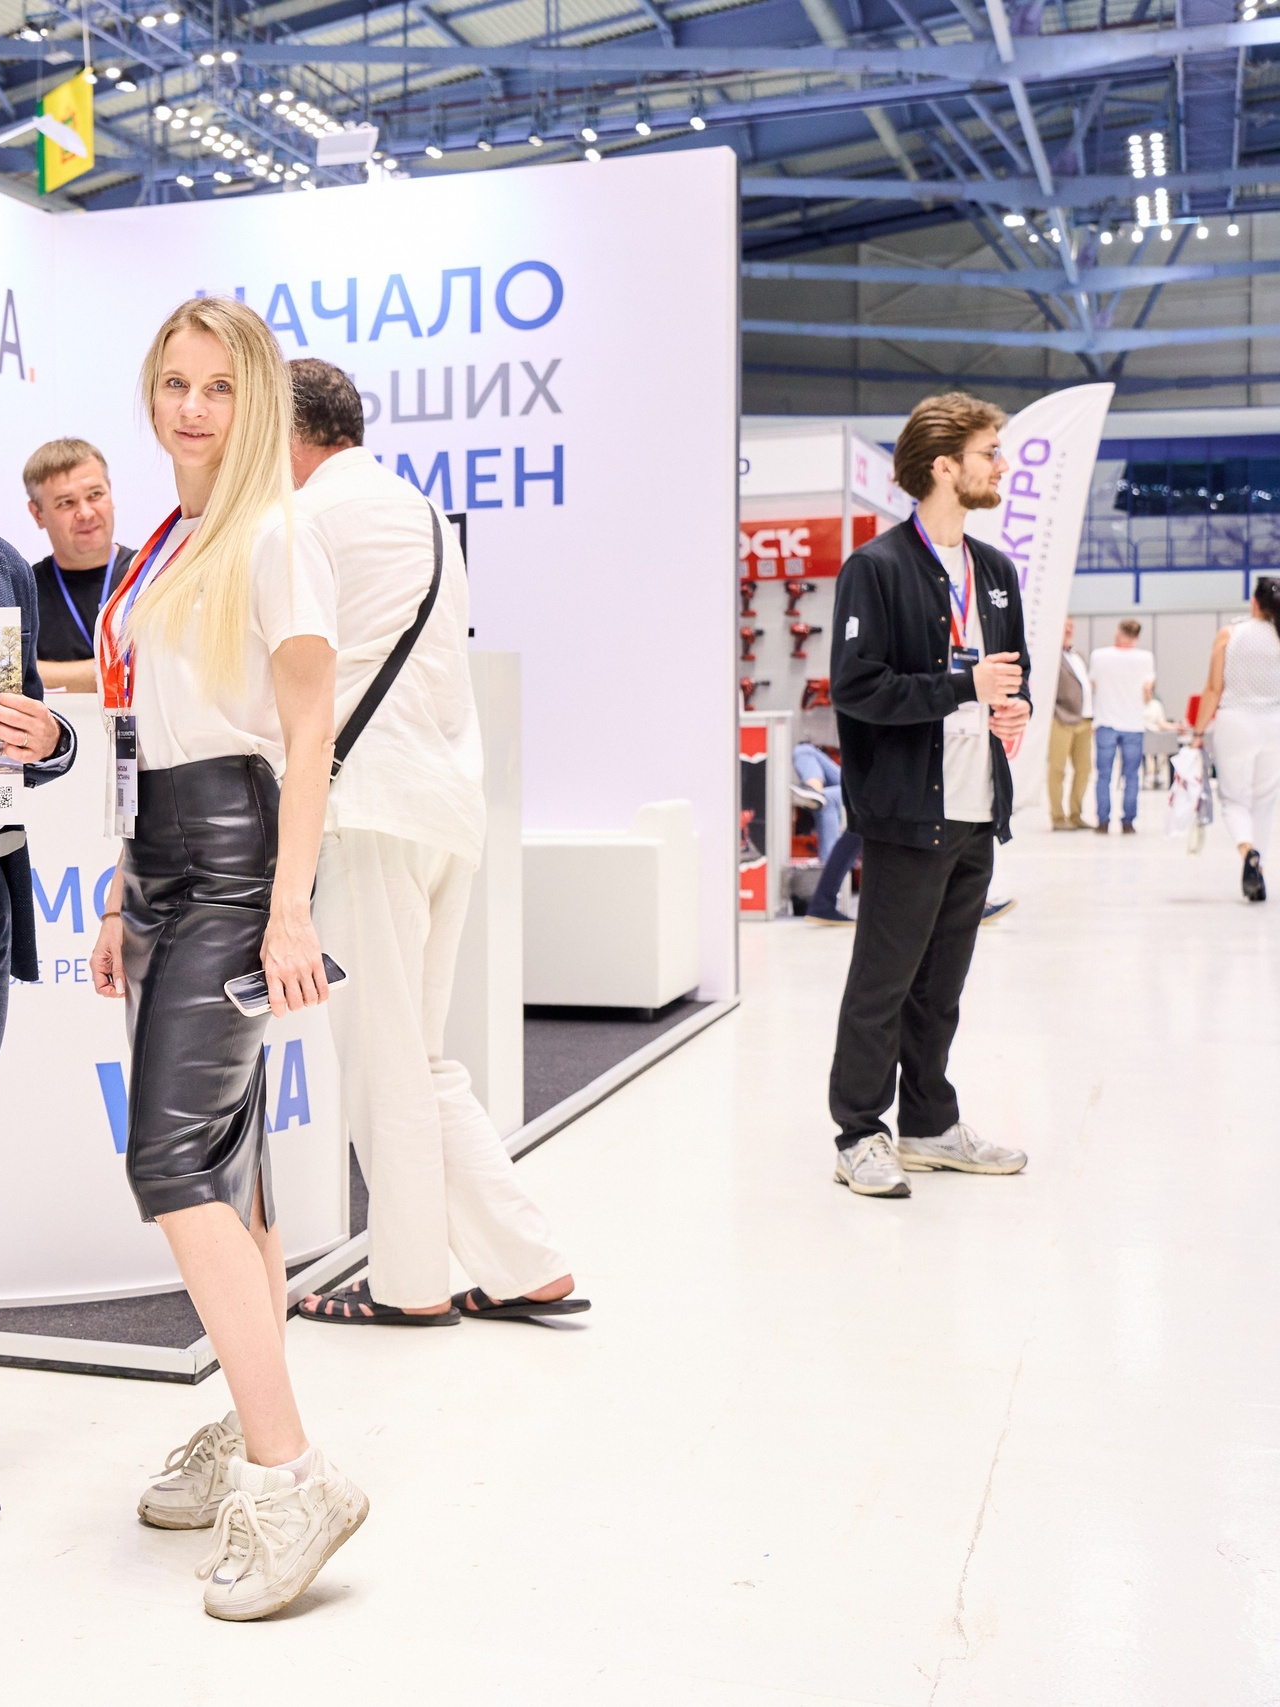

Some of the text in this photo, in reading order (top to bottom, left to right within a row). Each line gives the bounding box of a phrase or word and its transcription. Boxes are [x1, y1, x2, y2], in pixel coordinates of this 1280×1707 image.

[196, 260, 564, 347] АЧАЛО
[375, 445, 564, 511] МЕН
[55, 958, 95, 984] РЕ
